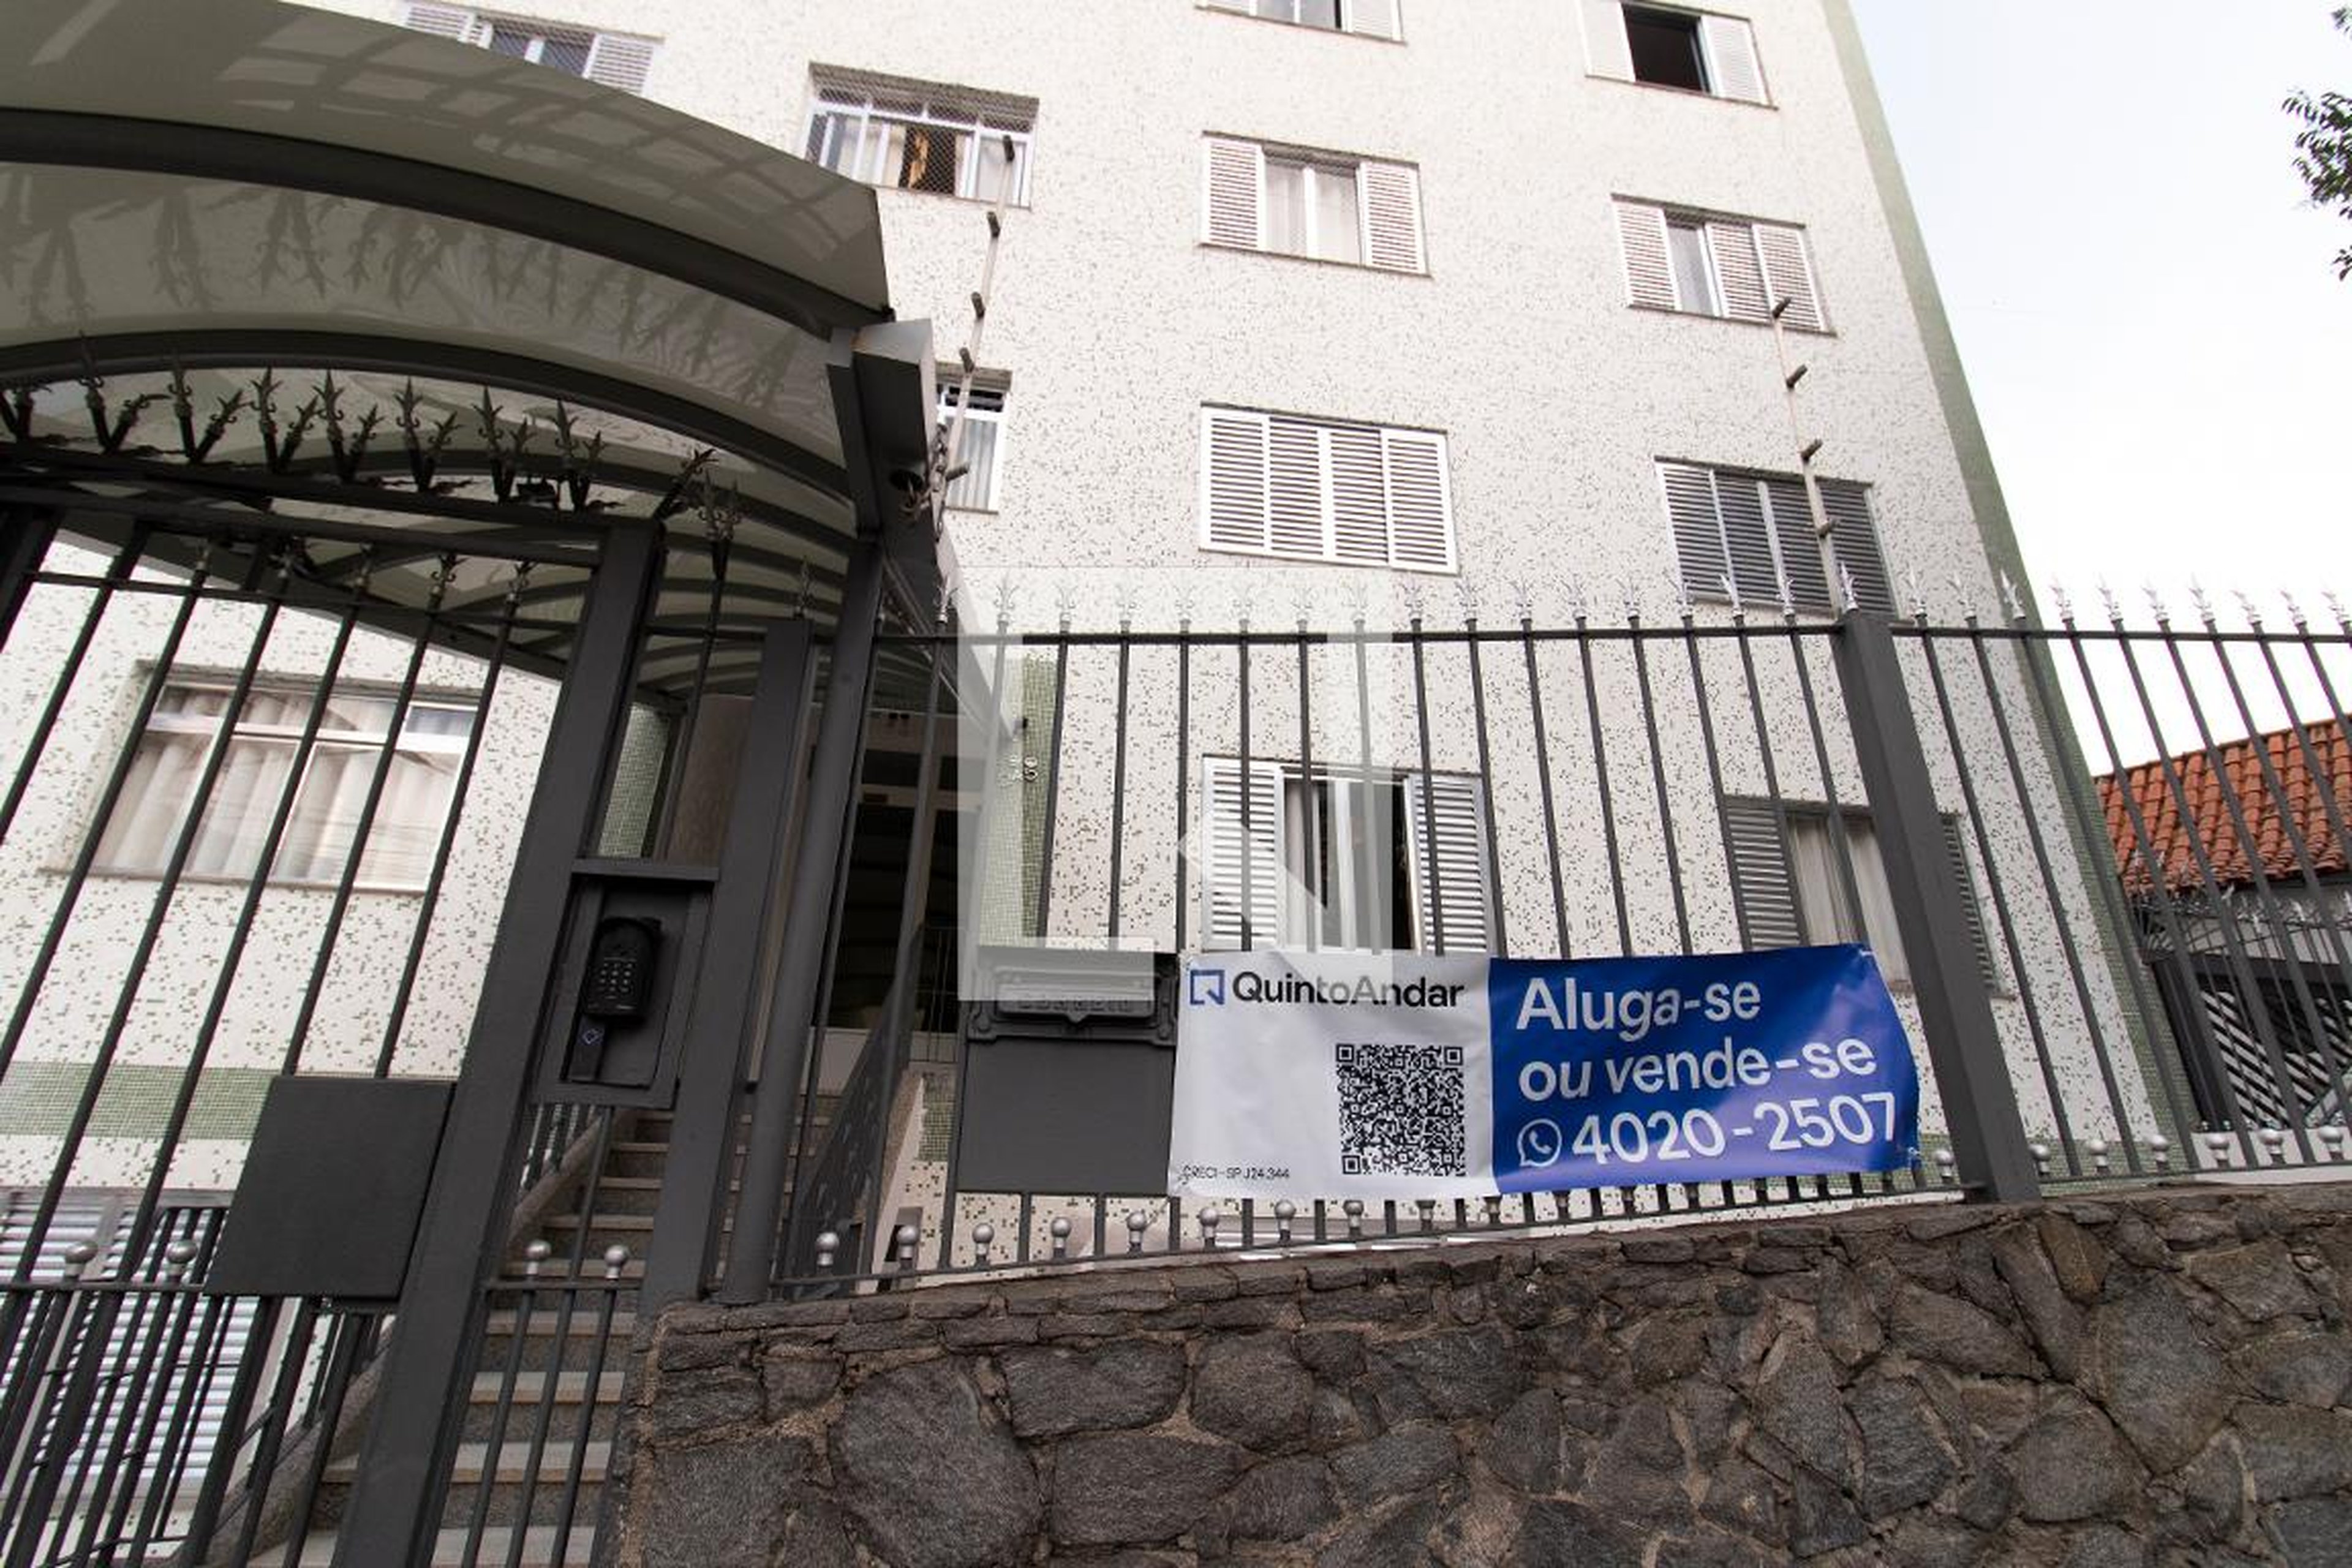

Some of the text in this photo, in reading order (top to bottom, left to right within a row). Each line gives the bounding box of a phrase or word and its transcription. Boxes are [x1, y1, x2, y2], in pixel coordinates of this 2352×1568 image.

[1233, 971, 1465, 1008] QuintoAndar
[1517, 977, 1761, 1042] Aluga-se
[1518, 1036, 1877, 1101] ou vende-se
[1572, 1091, 1896, 1164] 4020-2507
